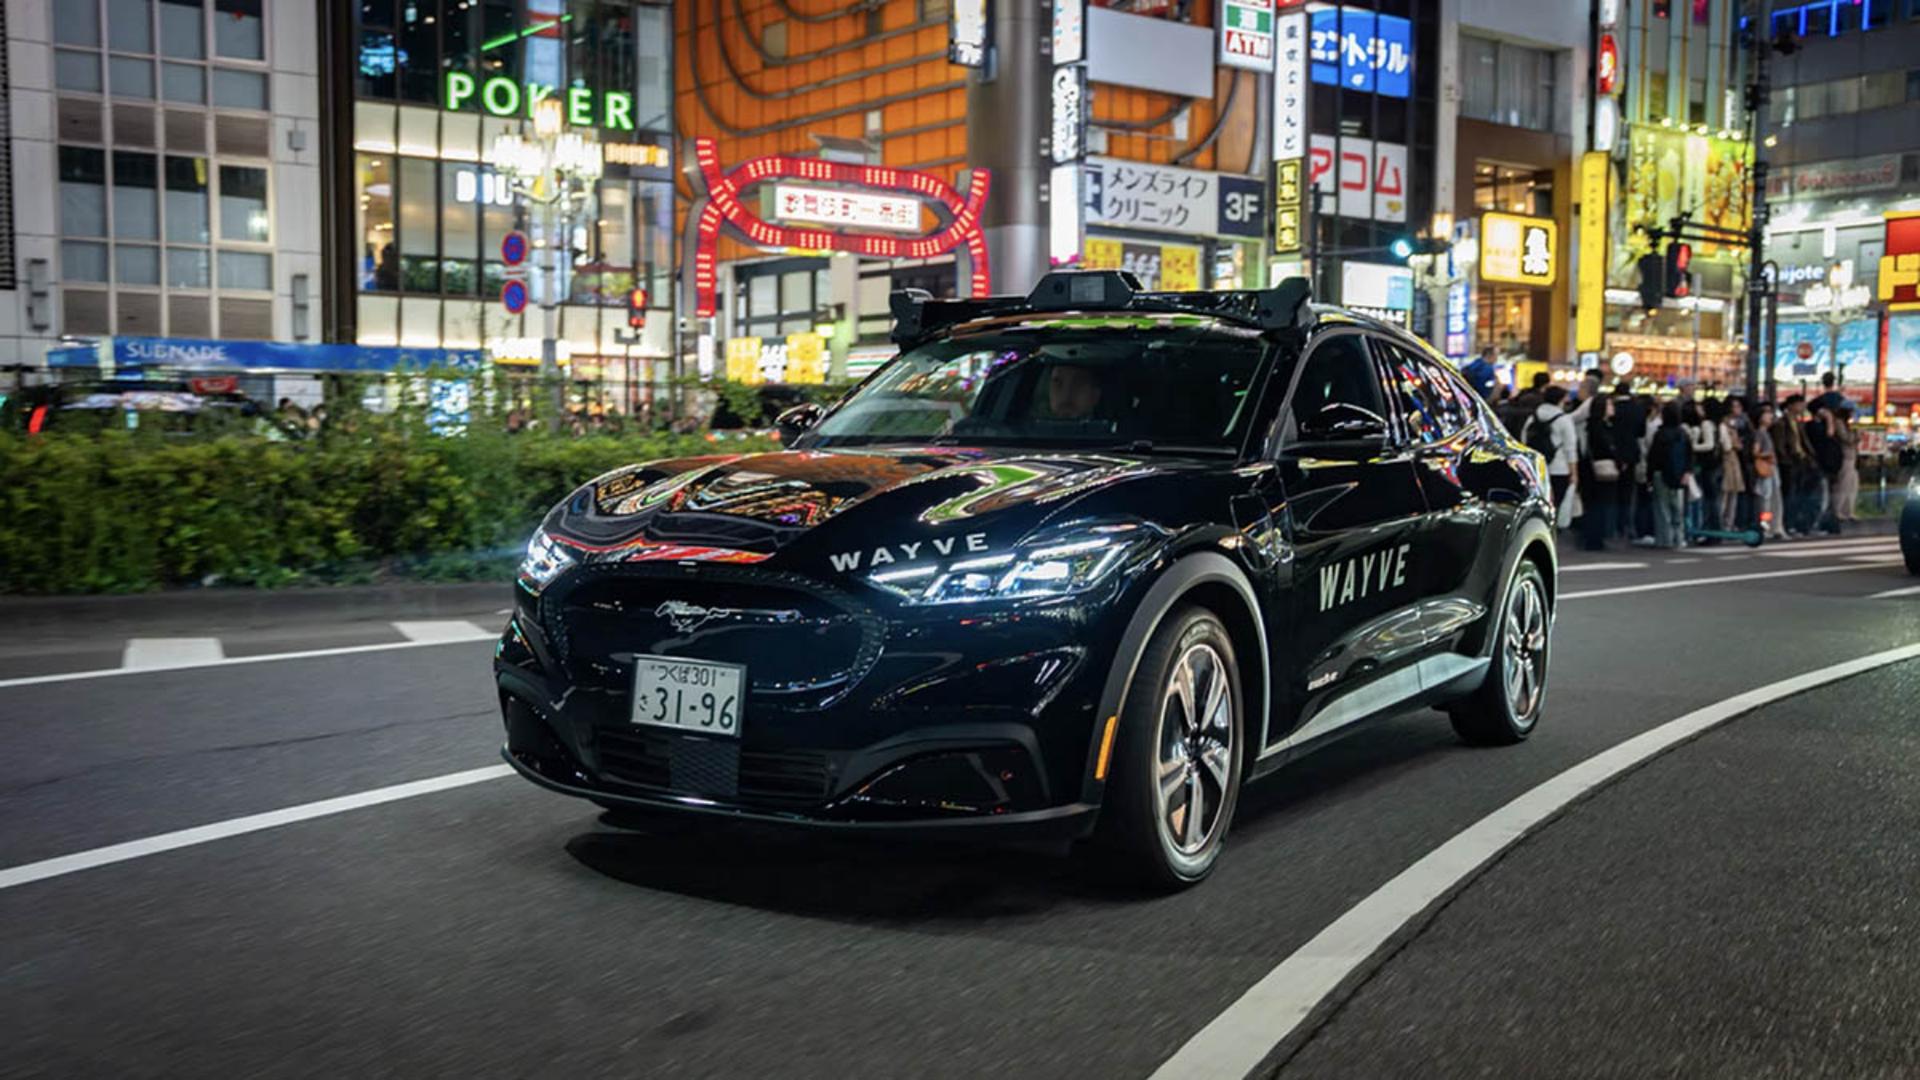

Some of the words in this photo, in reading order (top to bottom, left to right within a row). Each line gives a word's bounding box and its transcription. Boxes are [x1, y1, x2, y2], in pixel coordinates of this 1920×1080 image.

[1228, 32, 1269, 58] ATM
[446, 71, 634, 131] POKER
[1108, 166, 1207, 199] メンズライフ
[1308, 148, 1402, 195] アコム
[1108, 197, 1189, 227] クリニック
[1224, 192, 1259, 223] 3F
[829, 532, 989, 573] WAYVE
[1319, 543, 1411, 612] WAYVE
[653, 687, 735, 730] 31-96
